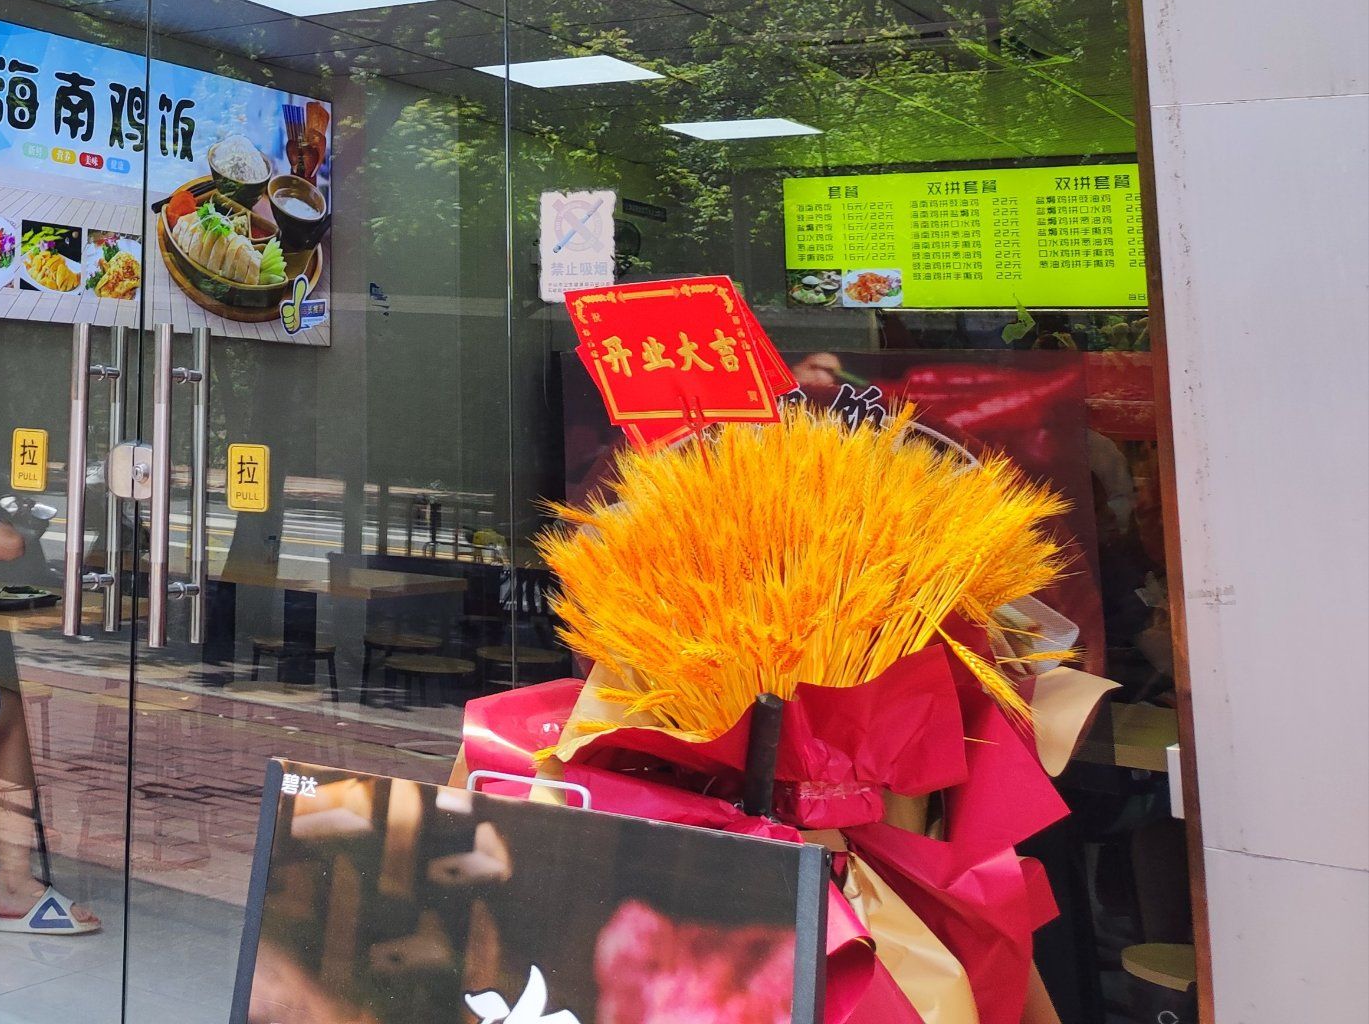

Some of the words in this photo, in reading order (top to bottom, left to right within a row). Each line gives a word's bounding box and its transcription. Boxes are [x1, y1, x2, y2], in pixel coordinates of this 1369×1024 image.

[926, 179, 998, 196] 双拼套餐
[1054, 173, 1131, 190] 双拼套餐
[827, 184, 859, 200] 套餐
[992, 196, 1019, 206] 22元
[993, 207, 1019, 216] 22元
[994, 218, 1020, 227] 22元
[994, 228, 1020, 237] 22元
[995, 239, 1021, 248] 22元
[995, 250, 1022, 259] 22元
[550, 260, 609, 276] 禁止吸烟
[996, 260, 1022, 269] 22元
[996, 271, 1023, 280] 22元
[601, 328, 740, 378] 开业大吉
[20, 438, 39, 467] 拉
[18, 470, 38, 482] PULL
[237, 455, 259, 485] 拉
[235, 490, 260, 502] PULL
[280, 772, 318, 799] 碧达
